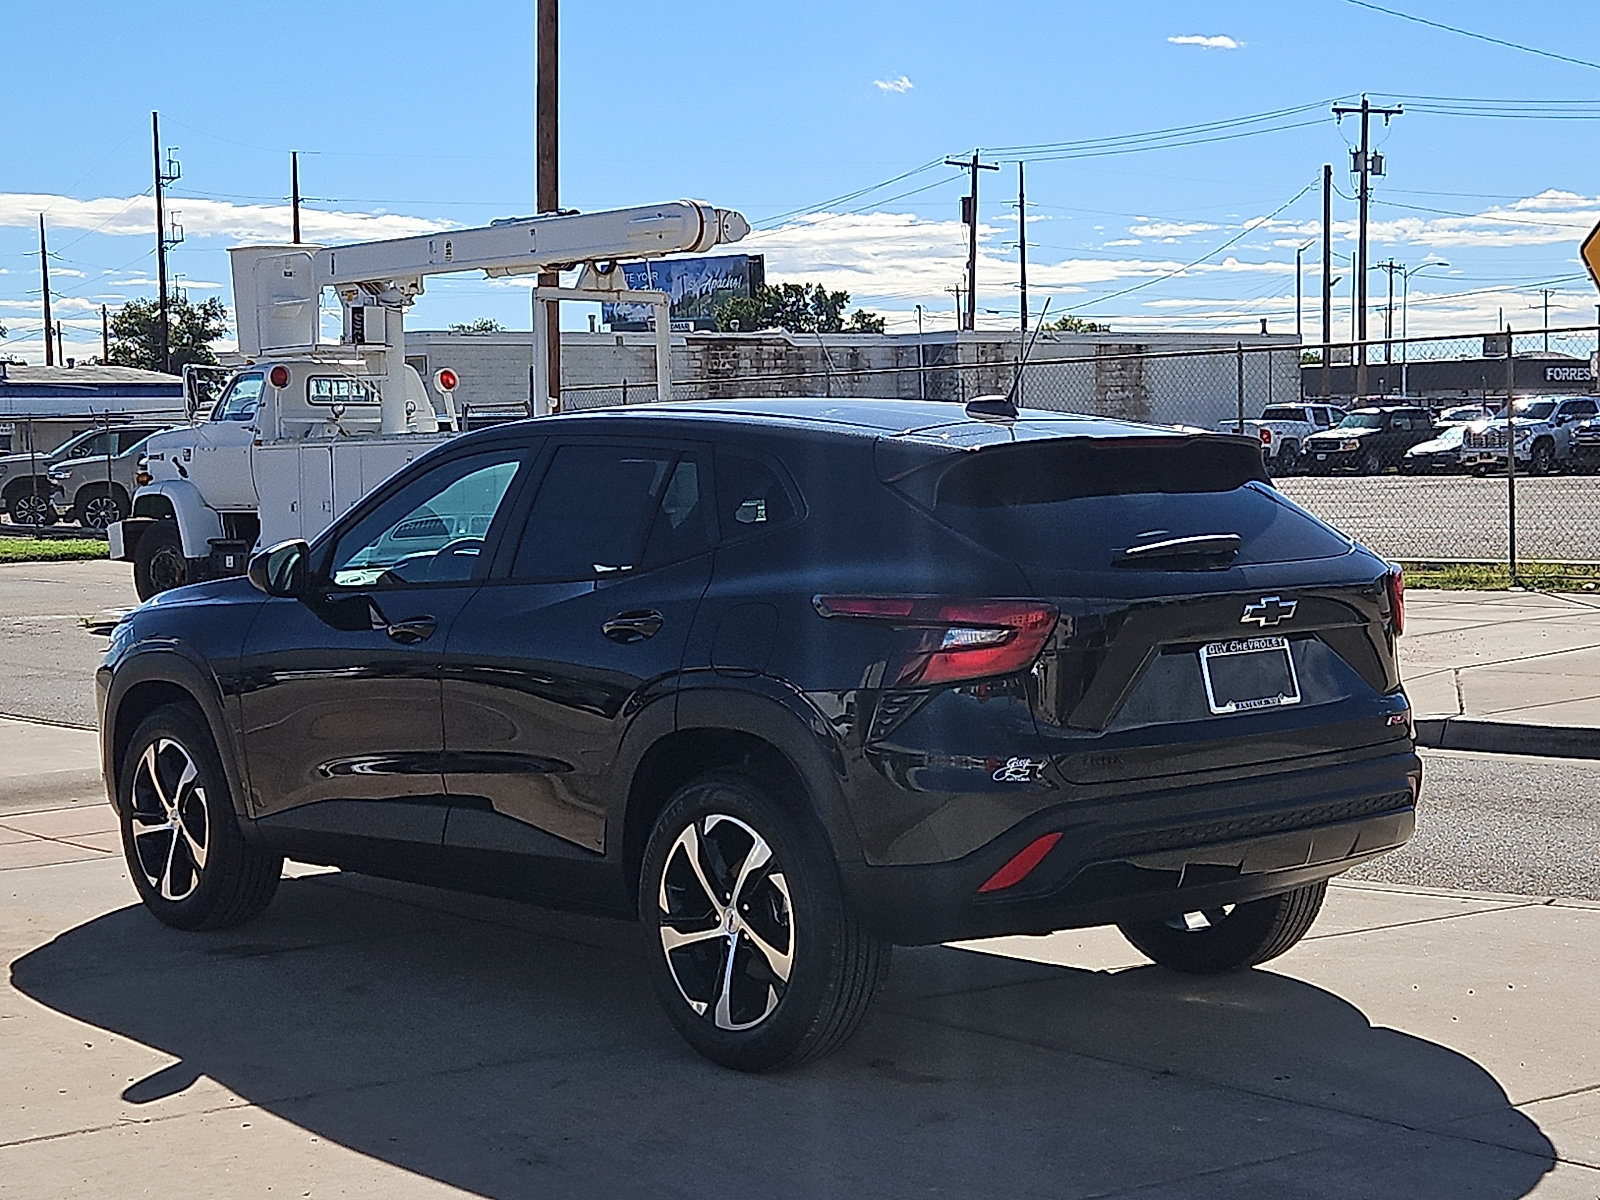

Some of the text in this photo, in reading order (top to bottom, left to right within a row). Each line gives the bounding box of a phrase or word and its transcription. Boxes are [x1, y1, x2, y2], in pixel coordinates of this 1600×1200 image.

[636, 272, 659, 282] YOR
[1545, 367, 1592, 381] FORRES
[1229, 636, 1285, 652] CHEVROLET
